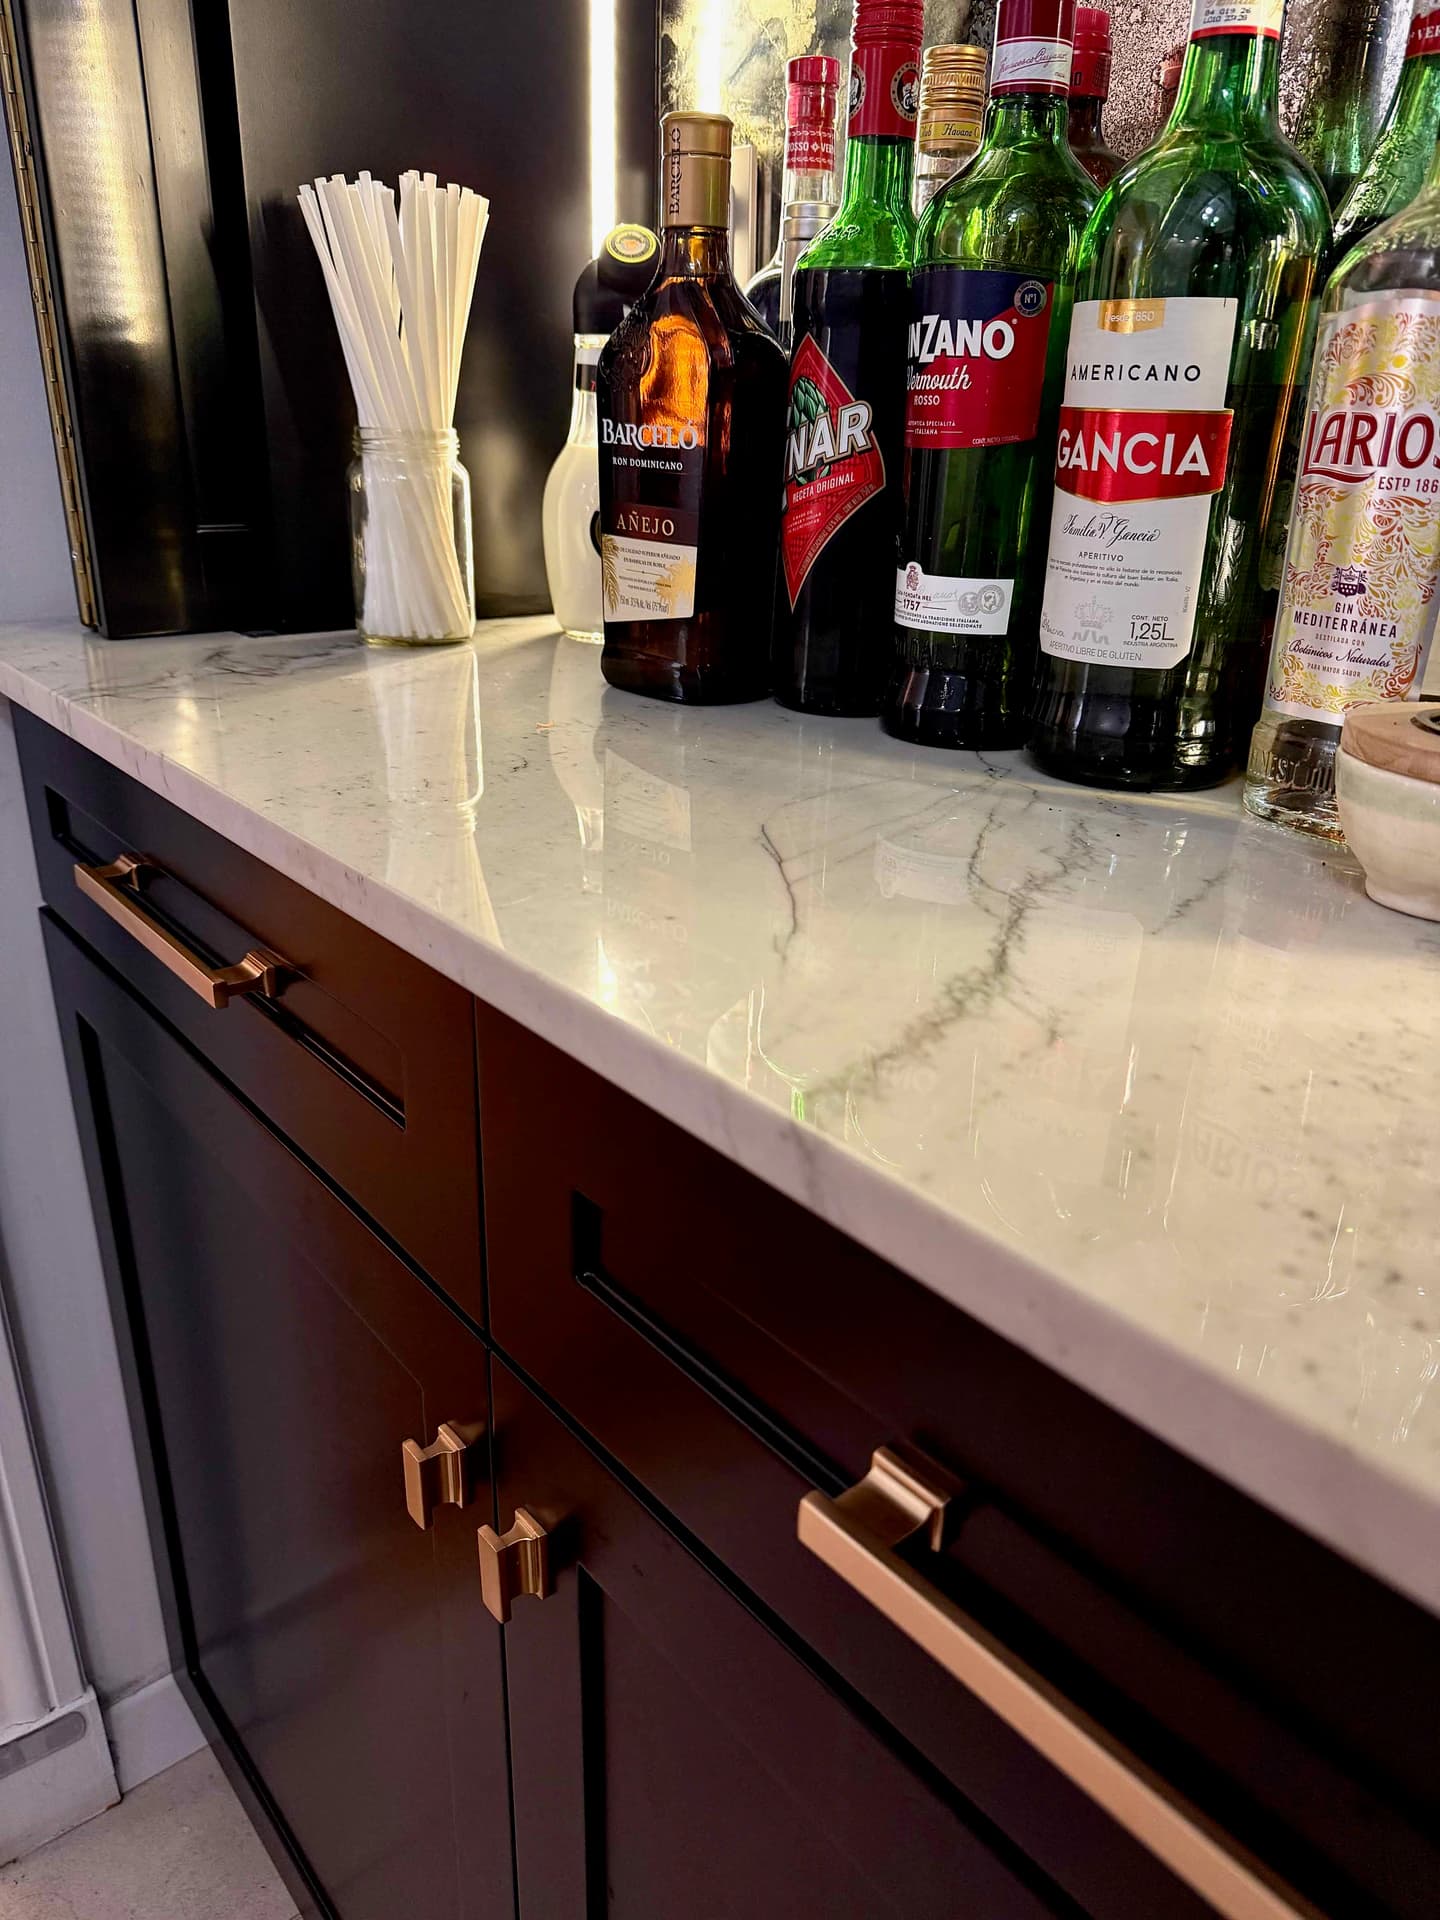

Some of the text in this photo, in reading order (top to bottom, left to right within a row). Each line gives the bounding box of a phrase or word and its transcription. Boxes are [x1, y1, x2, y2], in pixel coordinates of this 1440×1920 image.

[669, 127, 682, 215] BARCELÓ
[1071, 364, 1201, 382] AMERICANO
[914, 395, 940, 406] ROSSO
[602, 418, 698, 451] BARCELÓ
[1056, 428, 1211, 476] GANCIA
[1302, 410, 1440, 484] LARIO
[612, 456, 683, 471] RON DOMINICANO
[816, 472, 855, 495] ORIGINAL
[617, 510, 675, 536] AÑEJO
[1078, 551, 1124, 562] APERITIVO
[903, 598, 921, 612] 1757
[1335, 602, 1354, 615] GIN
[1130, 621, 1175, 641] 1,25L
[1294, 610, 1397, 639] MEDITERRÁNEA
[1315, 633, 1349, 645] DESTILADA
[1075, 645, 1096, 656] LIBRE
[1097, 649, 1108, 658] DE
[1288, 638, 1391, 668] Botánicos Naturales
[1307, 662, 1361, 678] PARA MAYOR SABOR
